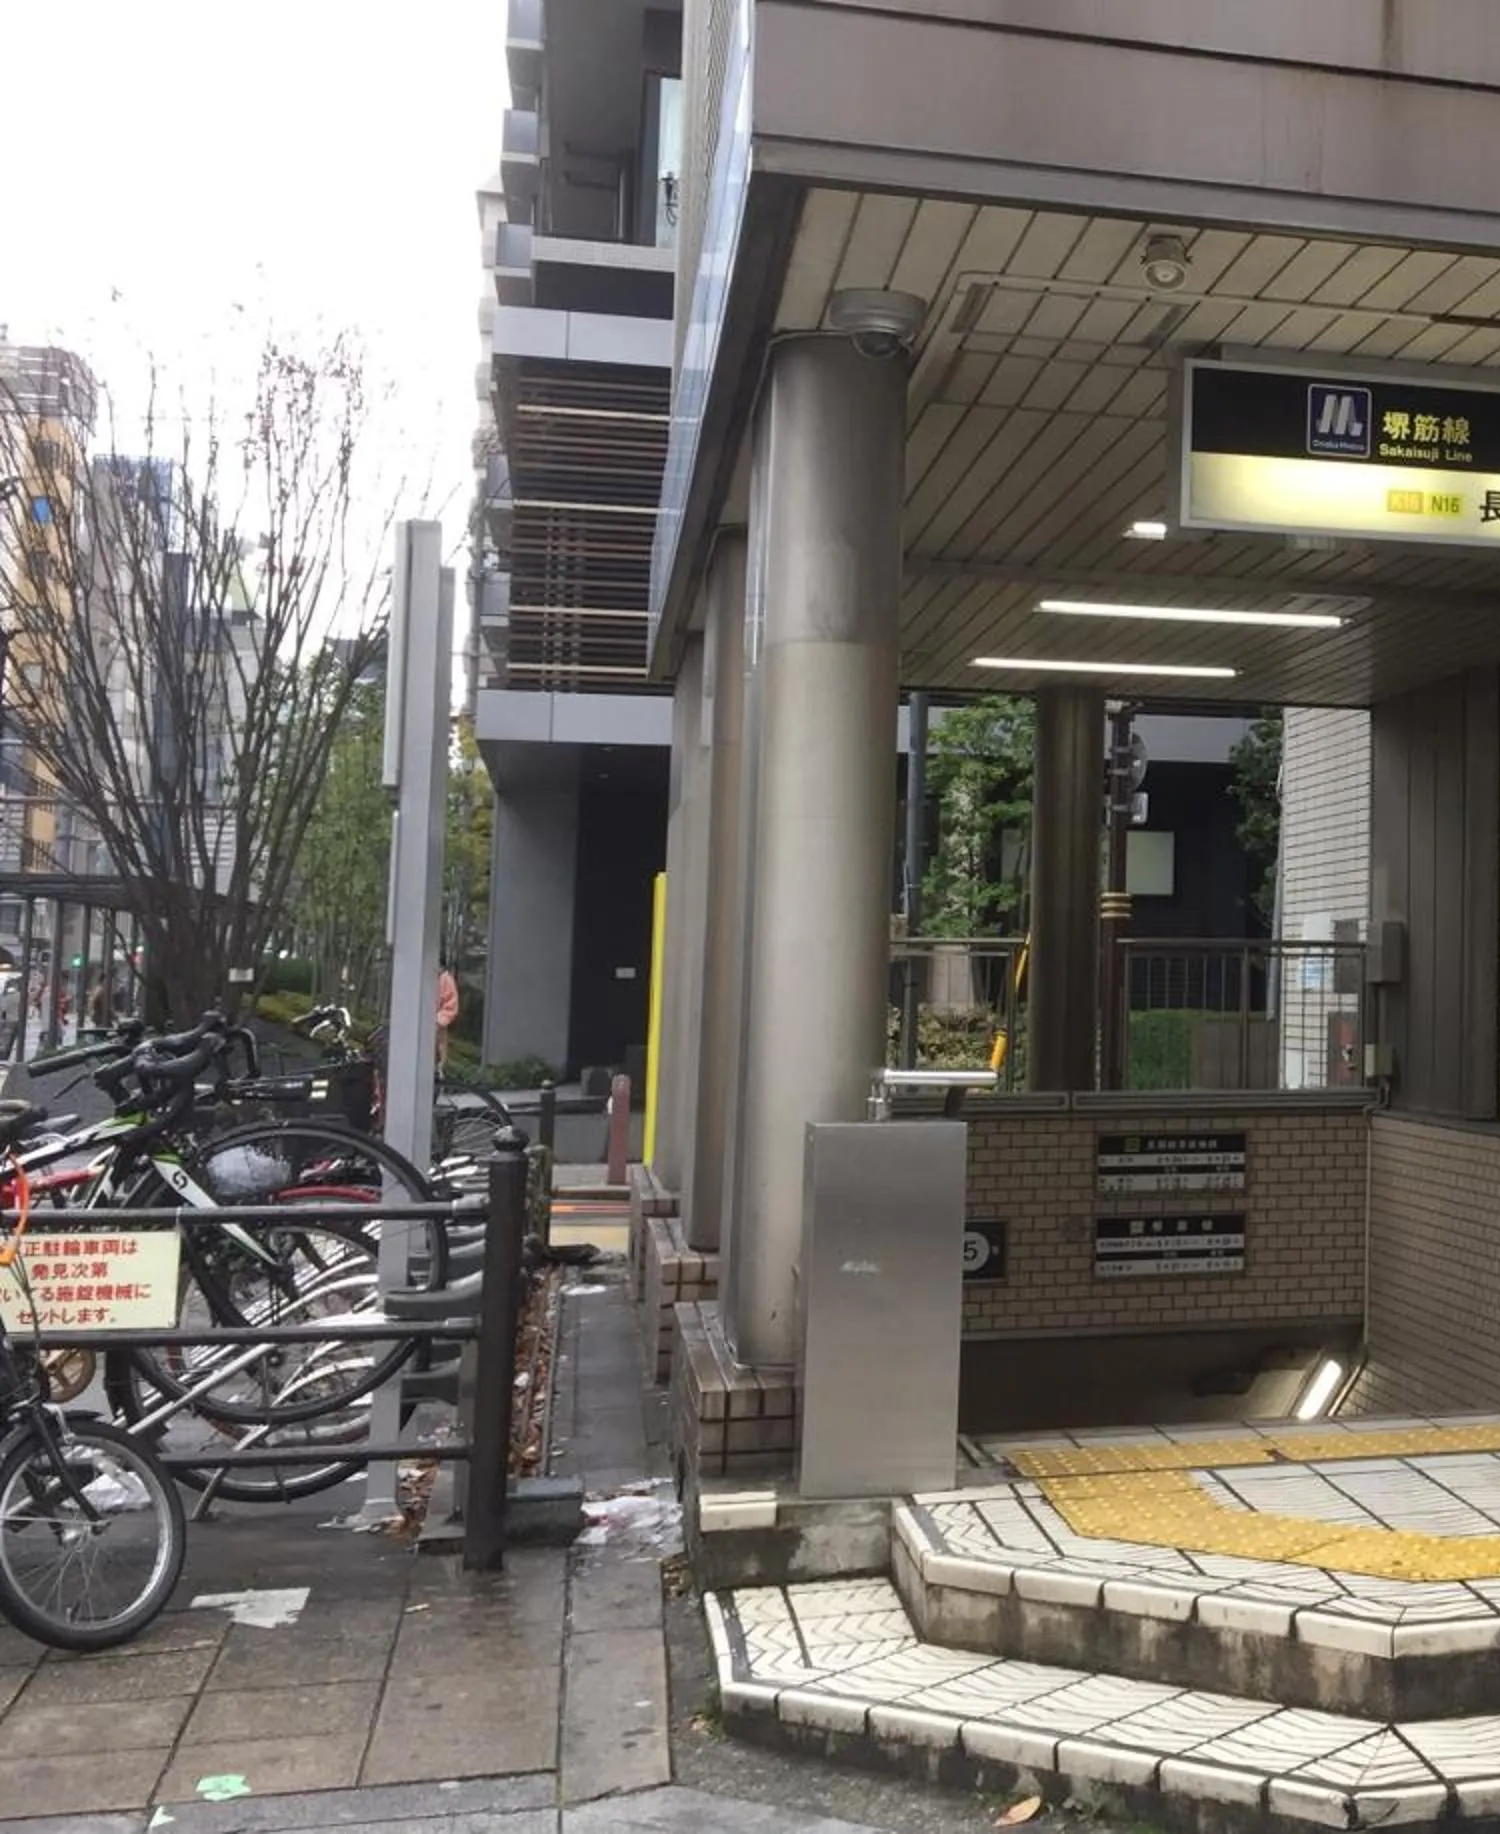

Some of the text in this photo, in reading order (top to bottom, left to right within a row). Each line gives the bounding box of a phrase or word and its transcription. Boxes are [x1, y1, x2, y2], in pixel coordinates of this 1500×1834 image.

[1382, 411, 1470, 445] 堺筋線
[1379, 443, 1473, 462] Sakaisuji Line
[1431, 495, 1460, 513] N16
[23, 1238, 138, 1256] 正駐輪車両は
[963, 1240, 978, 1262] 5
[31, 1262, 109, 1280] 発見次第
[0, 1284, 152, 1303] いる施錠機械に
[16, 1307, 117, 1326] セットします。
